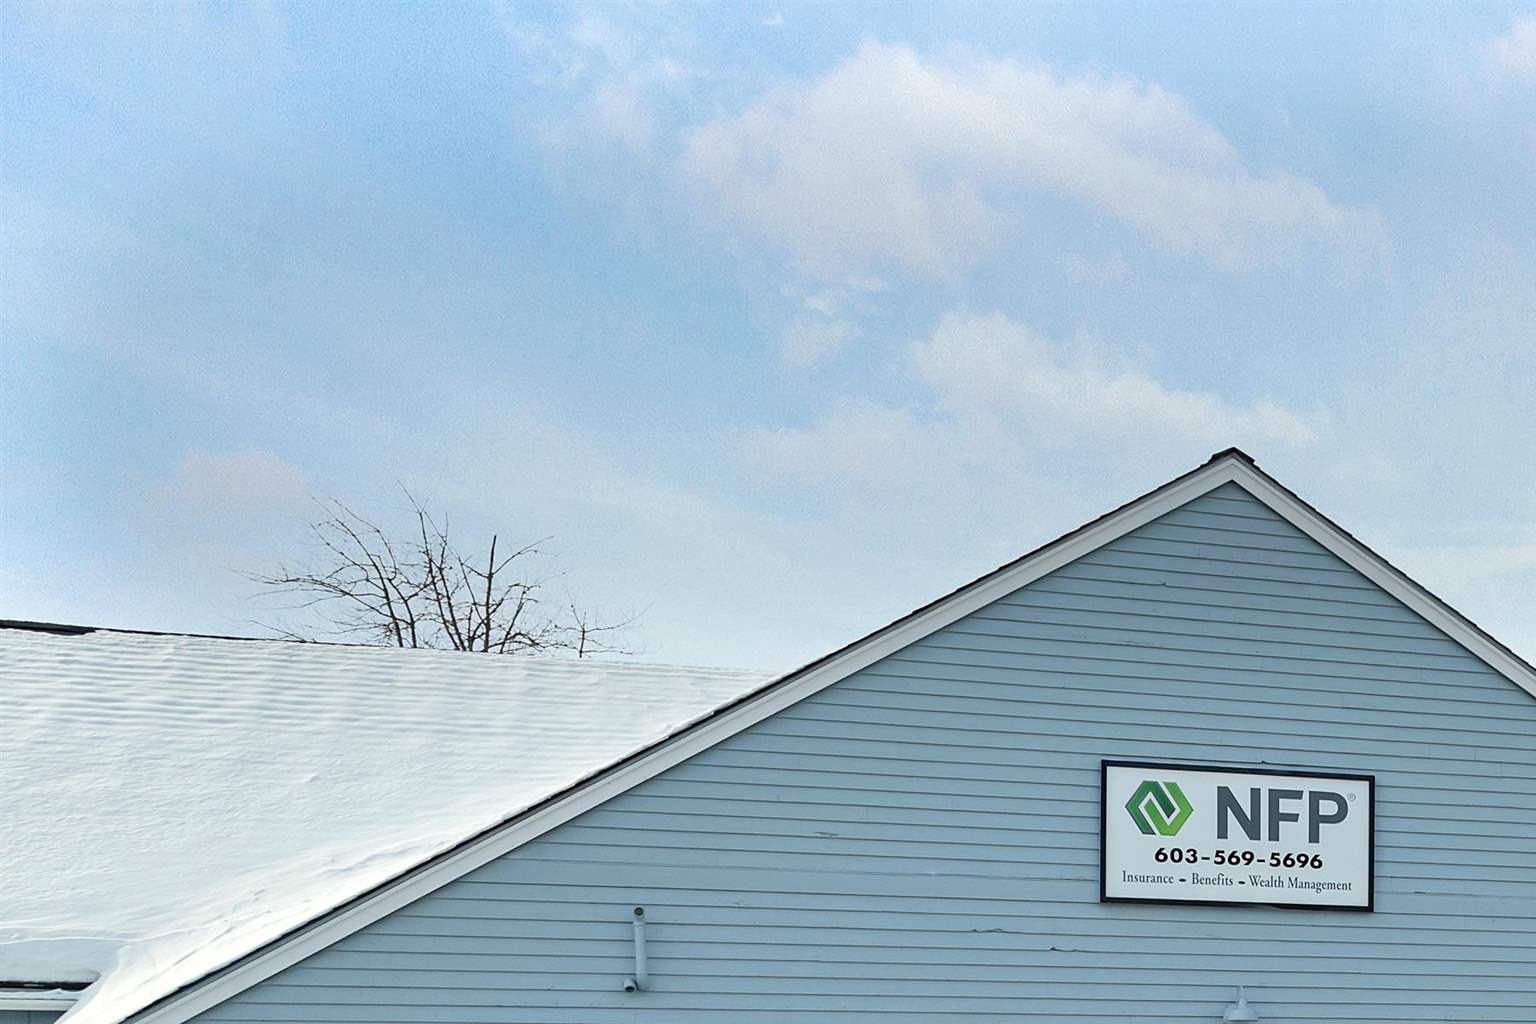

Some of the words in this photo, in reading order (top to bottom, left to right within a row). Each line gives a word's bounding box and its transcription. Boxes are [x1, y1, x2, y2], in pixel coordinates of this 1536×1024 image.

[1217, 786, 1349, 844] NFP
[1154, 847, 1323, 869] 603-569-5696
[1122, 870, 1174, 884] Insurance
[1191, 872, 1234, 886] Benefits
[1249, 875, 1284, 888] Wealth
[1288, 876, 1352, 894] Management
